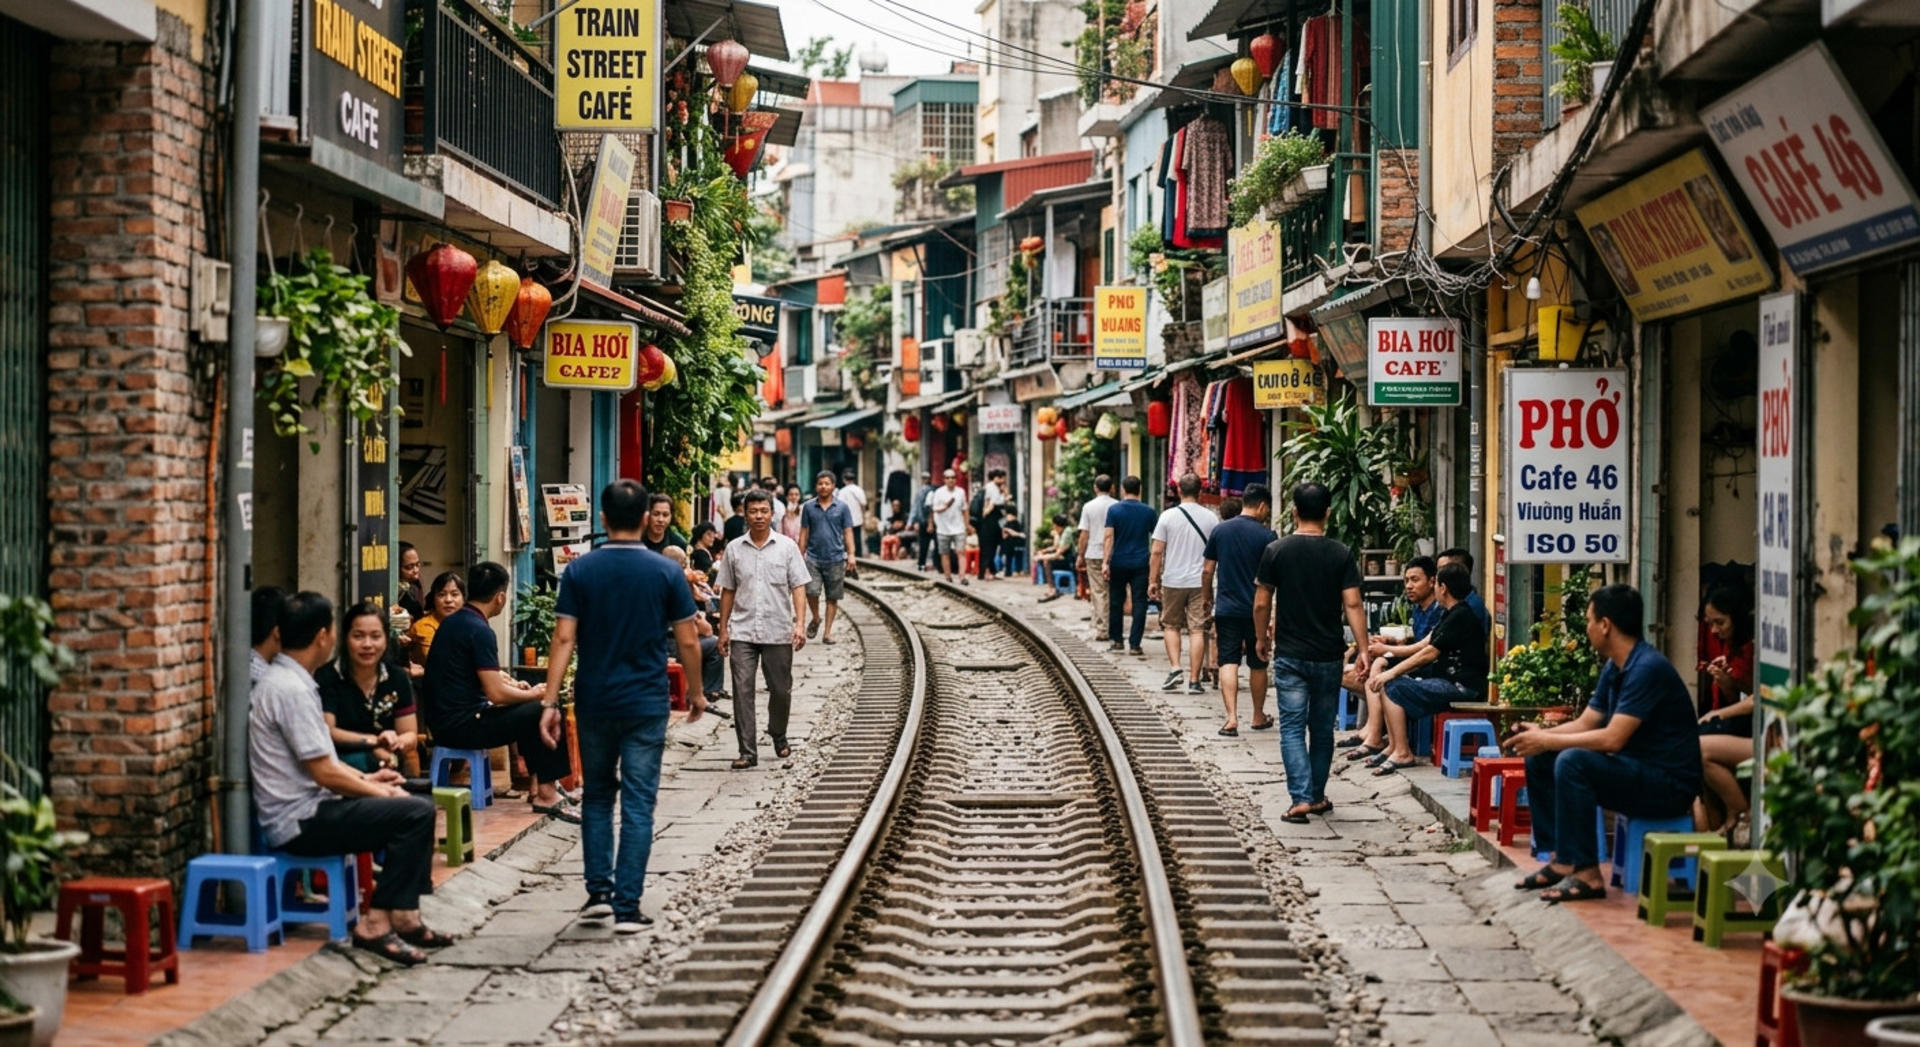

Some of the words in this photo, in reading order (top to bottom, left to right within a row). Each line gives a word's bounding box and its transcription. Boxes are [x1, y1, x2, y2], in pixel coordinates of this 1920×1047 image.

[574, 8, 639, 37] TRAIN
[315, 0, 354, 71] TRAIN
[357, 20, 403, 99] STREET
[567, 49, 647, 79] STREET
[579, 85, 632, 120] CAFÉ
[1745, 115, 1843, 229] CAFÉ
[1812, 114, 1883, 201] 46
[551, 332, 587, 357] BIA
[1377, 330, 1413, 353] BIA
[1518, 377, 1621, 449] PHỞ
[1521, 464, 1577, 490] Cafe
[1586, 464, 1618, 490] 46
[1528, 533, 1576, 554] ISO
[1585, 533, 1618, 554] 50
